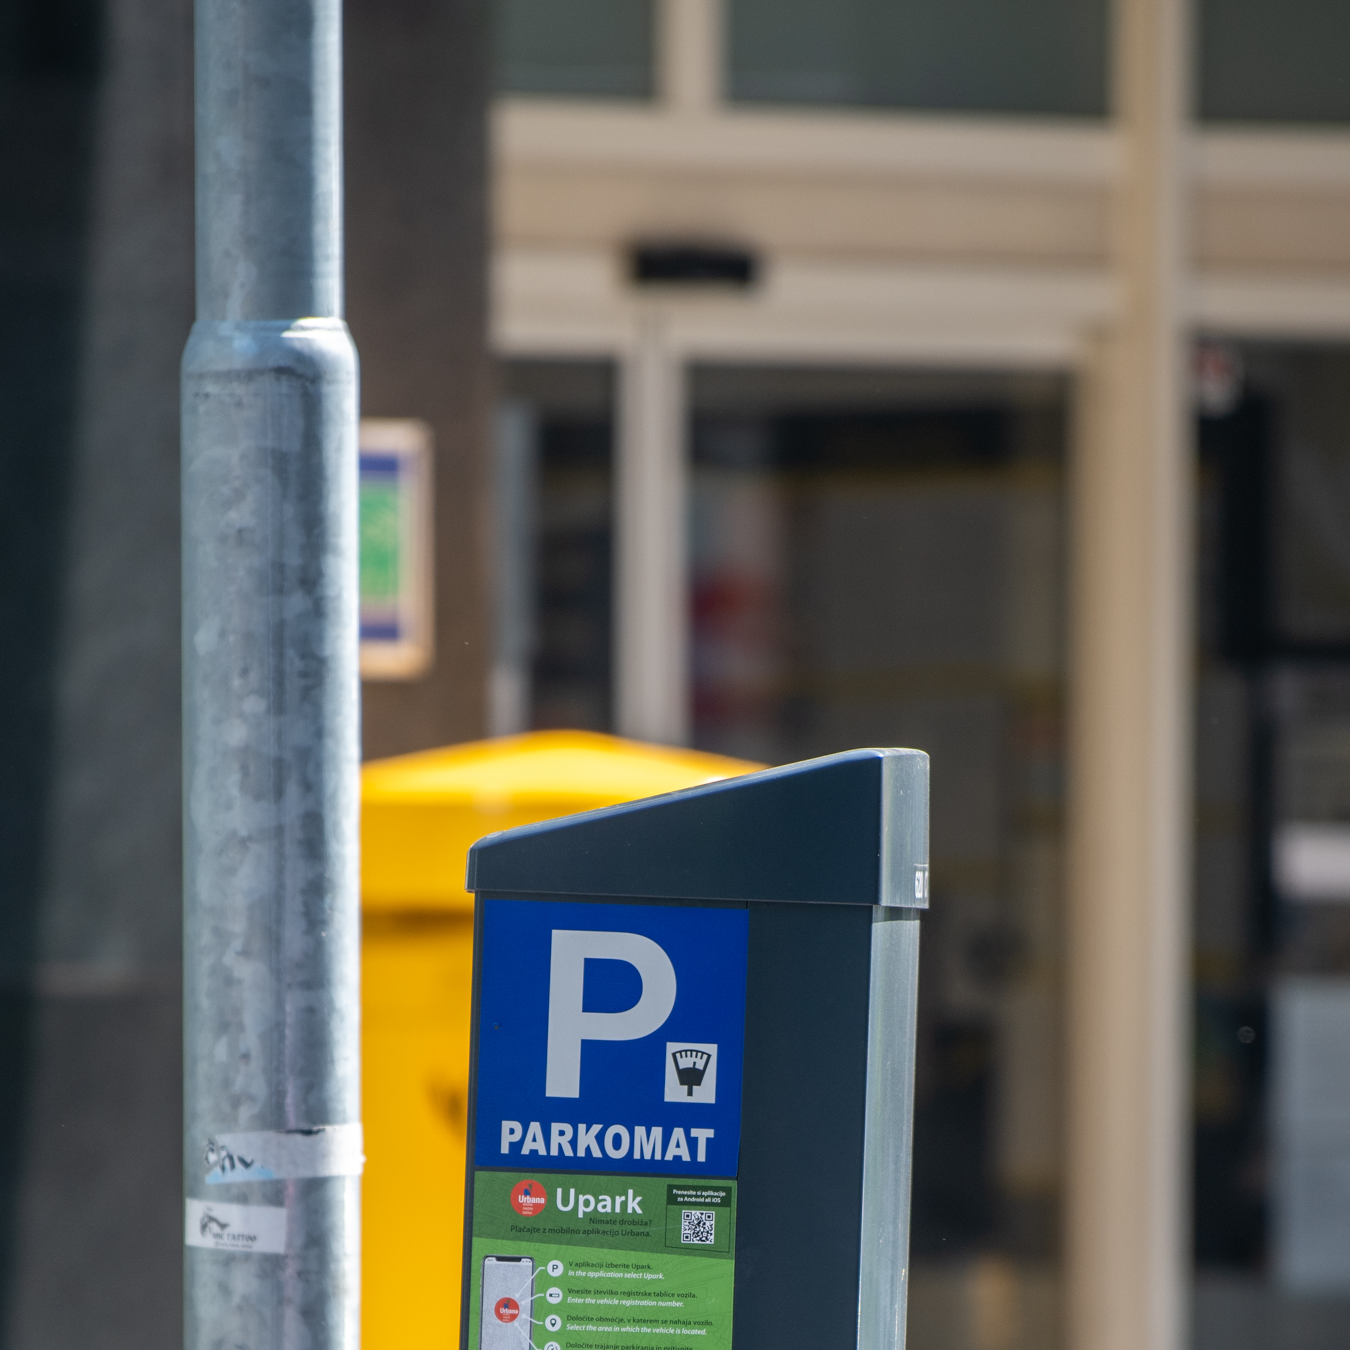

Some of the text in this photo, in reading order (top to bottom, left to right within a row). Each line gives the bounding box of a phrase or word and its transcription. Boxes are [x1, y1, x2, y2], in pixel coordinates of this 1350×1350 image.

[546, 929, 677, 1098] P
[500, 1120, 715, 1162] PARKOMAT
[518, 1195, 545, 1204] Urbana
[556, 1188, 643, 1218] Upark
[619, 1218, 653, 1227] drobiža?
[510, 1225, 540, 1234] Plačajte
[582, 1228, 619, 1237] aplikacijo
[575, 1261, 604, 1269] aplikaciji
[588, 1270, 623, 1279] application
[644, 1272, 665, 1281] Upark.
[620, 1290, 652, 1298] registrske
[620, 1298, 656, 1308] registration
